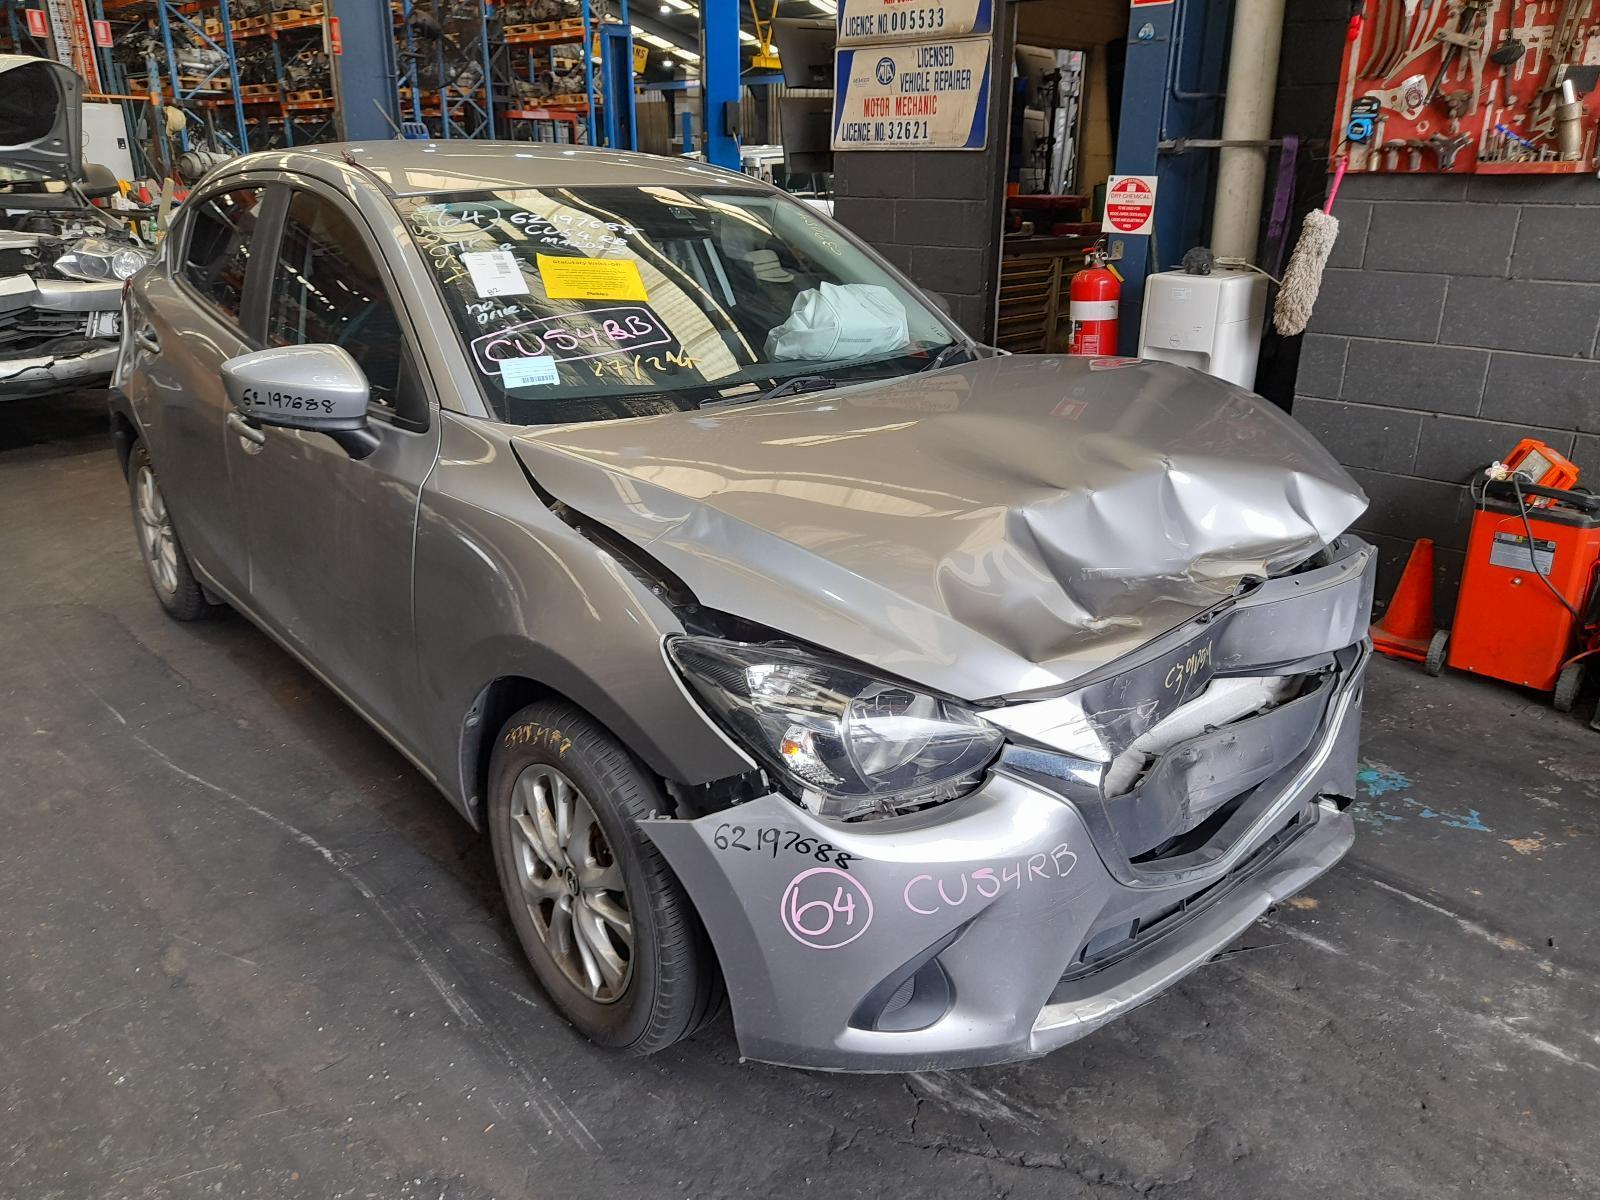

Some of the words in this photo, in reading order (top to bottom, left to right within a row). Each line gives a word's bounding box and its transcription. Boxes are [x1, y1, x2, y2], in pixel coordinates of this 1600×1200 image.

[845, 15, 874, 37] LICENCE
[877, 12, 889, 34] NO.
[891, 8, 944, 31] 005533
[917, 46, 954, 68] LICENSED
[900, 71, 930, 93] VEHICLE
[934, 69, 972, 91] REPAIRER
[863, 97, 890, 118] MOTOR
[895, 95, 938, 117] MECHANIC
[841, 123, 871, 142] LICENCE
[874, 122, 886, 142] NO.
[888, 121, 928, 140] 32621
[713, 823, 863, 870] 62197688
[791, 886, 856, 936] 64
